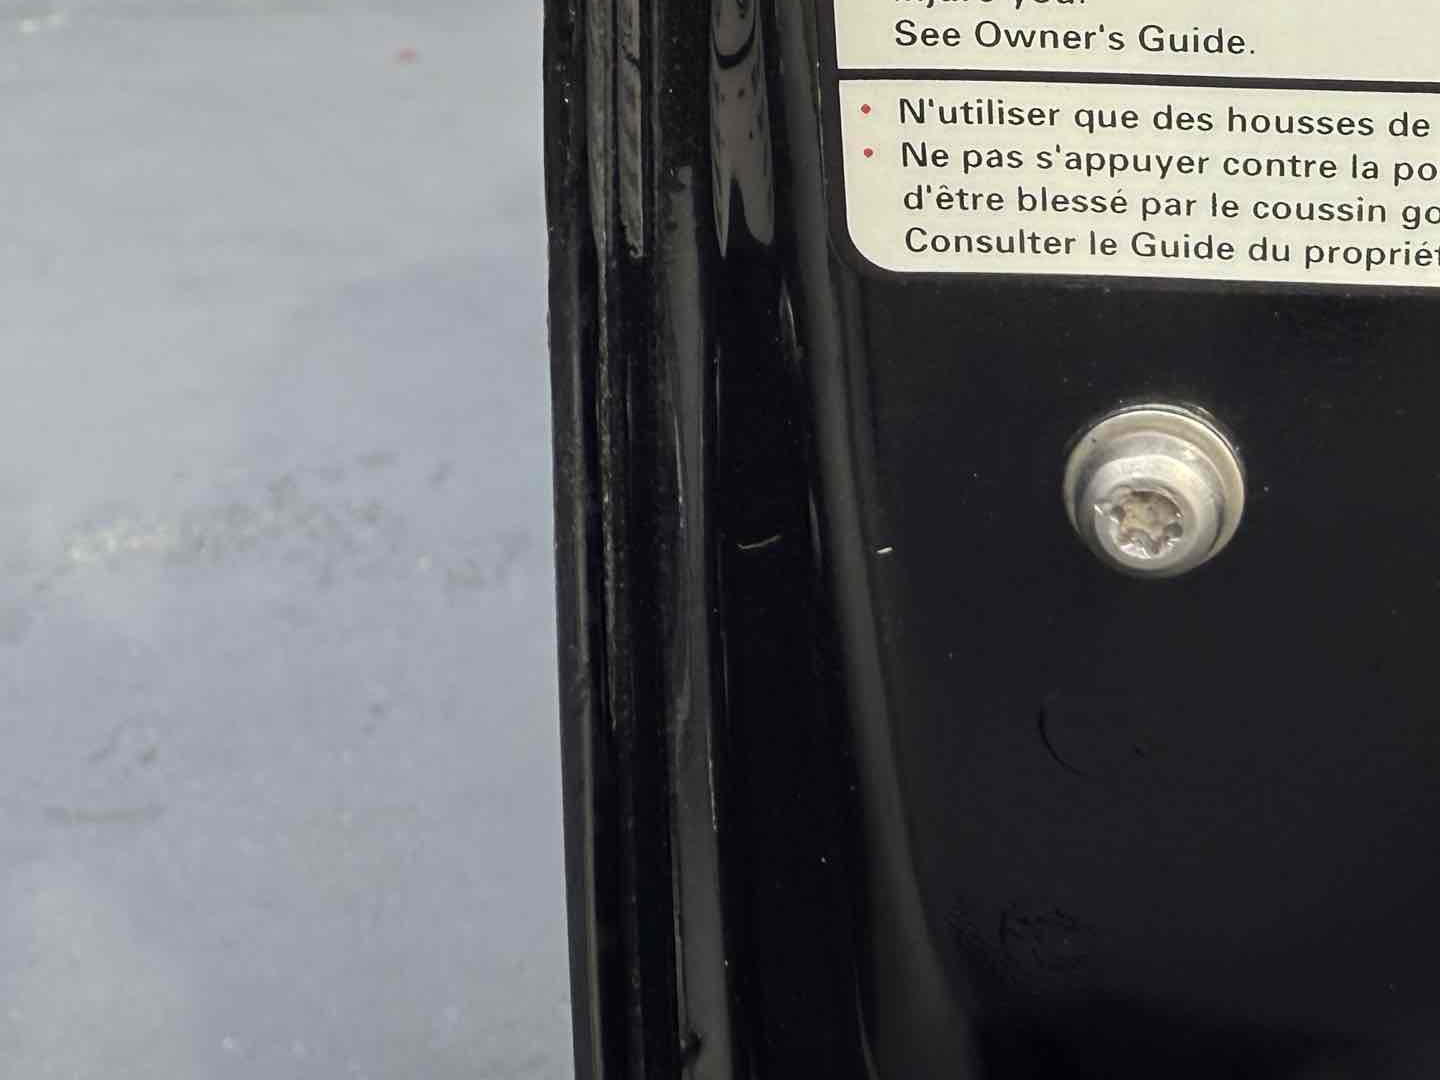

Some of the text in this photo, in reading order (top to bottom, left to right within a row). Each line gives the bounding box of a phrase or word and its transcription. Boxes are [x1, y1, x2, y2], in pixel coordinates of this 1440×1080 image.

[895, 19, 1256, 55] See Owner's Guide.
[899, 97, 1061, 127] N'utiliser
[1074, 105, 1140, 134] que
[1153, 104, 1214, 133] des
[1227, 106, 1375, 137] housses
[1388, 112, 1432, 139] de
[901, 141, 950, 169] Ne
[962, 146, 1025, 174] pas
[1036, 143, 1210, 180] s'appuyer
[1222, 154, 1338, 180] contre
[1351, 153, 1380, 180] la
[903, 184, 1005, 213] d'être
[1017, 186, 1128, 216] blessé
[1141, 192, 1198, 221] par
[1210, 192, 1240, 219] le
[1252, 197, 1388, 224] coussin
[904, 227, 1077, 256] Consulter
[1089, 229, 1118, 256] le
[1131, 231, 1236, 262] Guide
[1247, 235, 1291, 263] du
